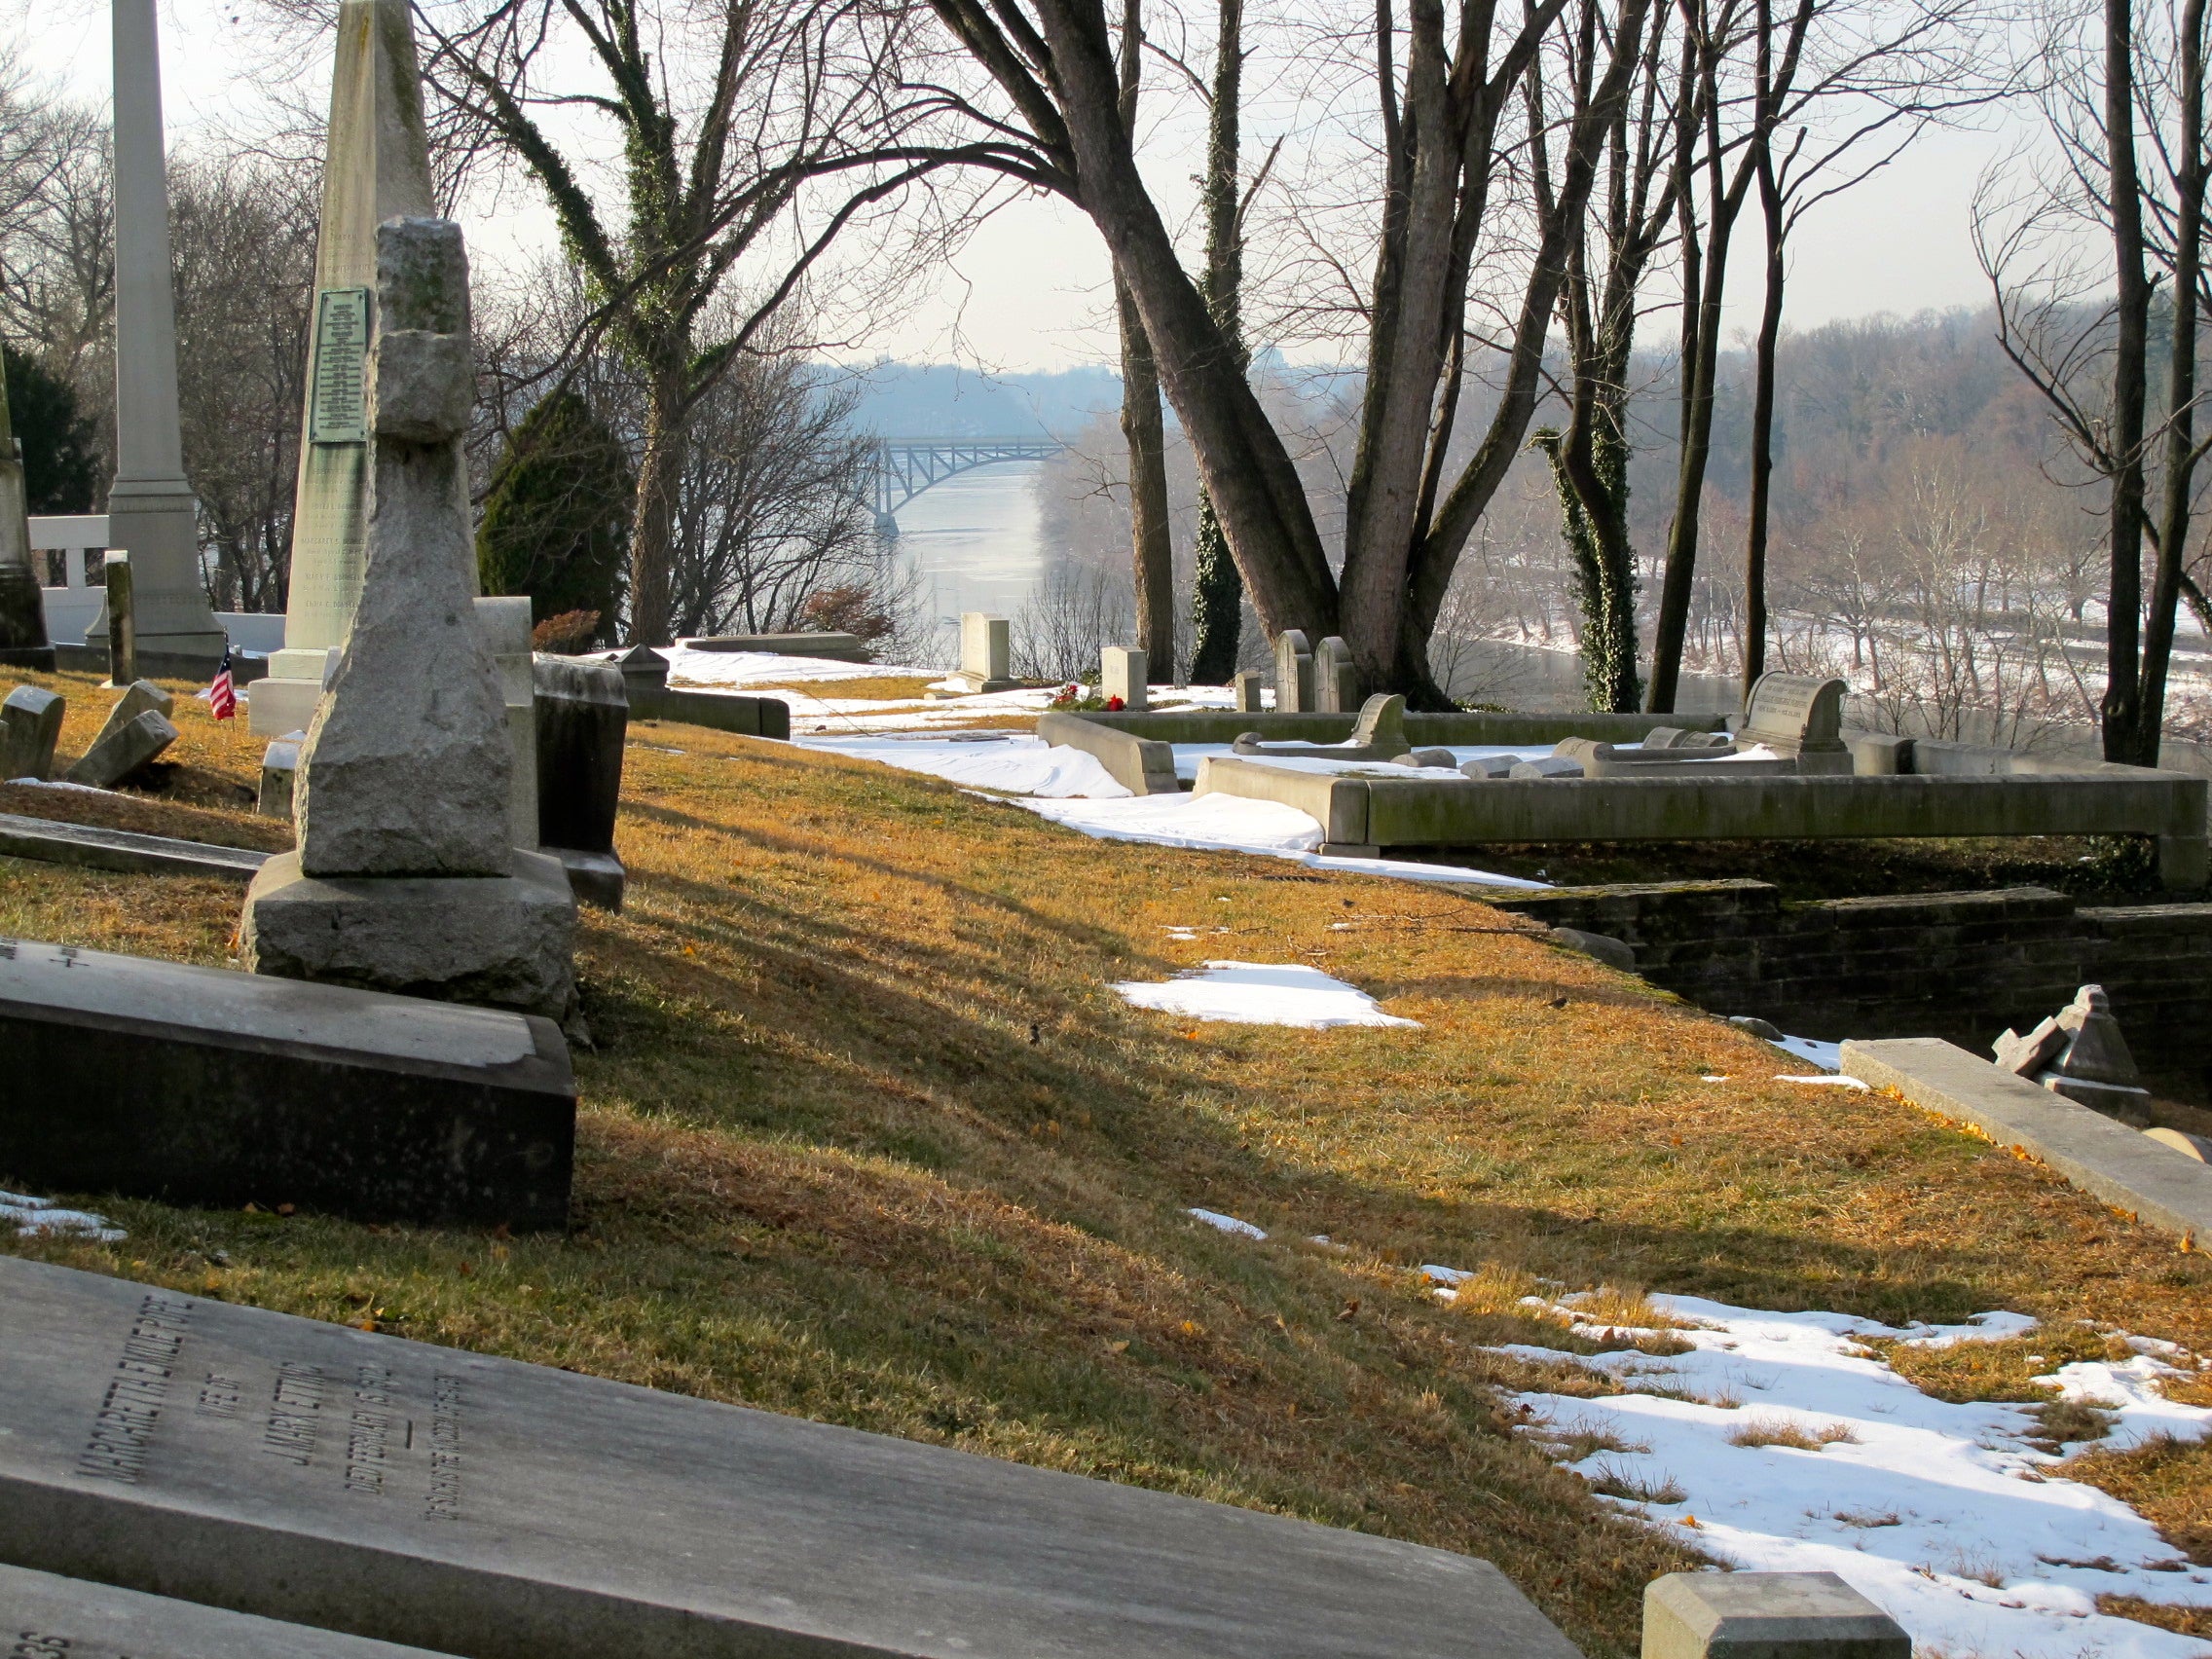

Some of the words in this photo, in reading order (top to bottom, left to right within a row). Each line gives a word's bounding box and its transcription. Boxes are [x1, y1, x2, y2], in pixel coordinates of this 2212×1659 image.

[138, 1294, 194, 1333] POPE
[119, 1327, 182, 1377] EMILIE
[204, 1373, 240, 1389] OF
[274, 1360, 326, 1410] ETTING
[196, 1390, 238, 1419] WIFE
[76, 1376, 166, 1483] MARGARETTA
[264, 1408, 317, 1452] MARX
[347, 1409, 387, 1465] FEBRUARY
[344, 1464, 383, 1494] DIED
[429, 1452, 460, 1470] THE
